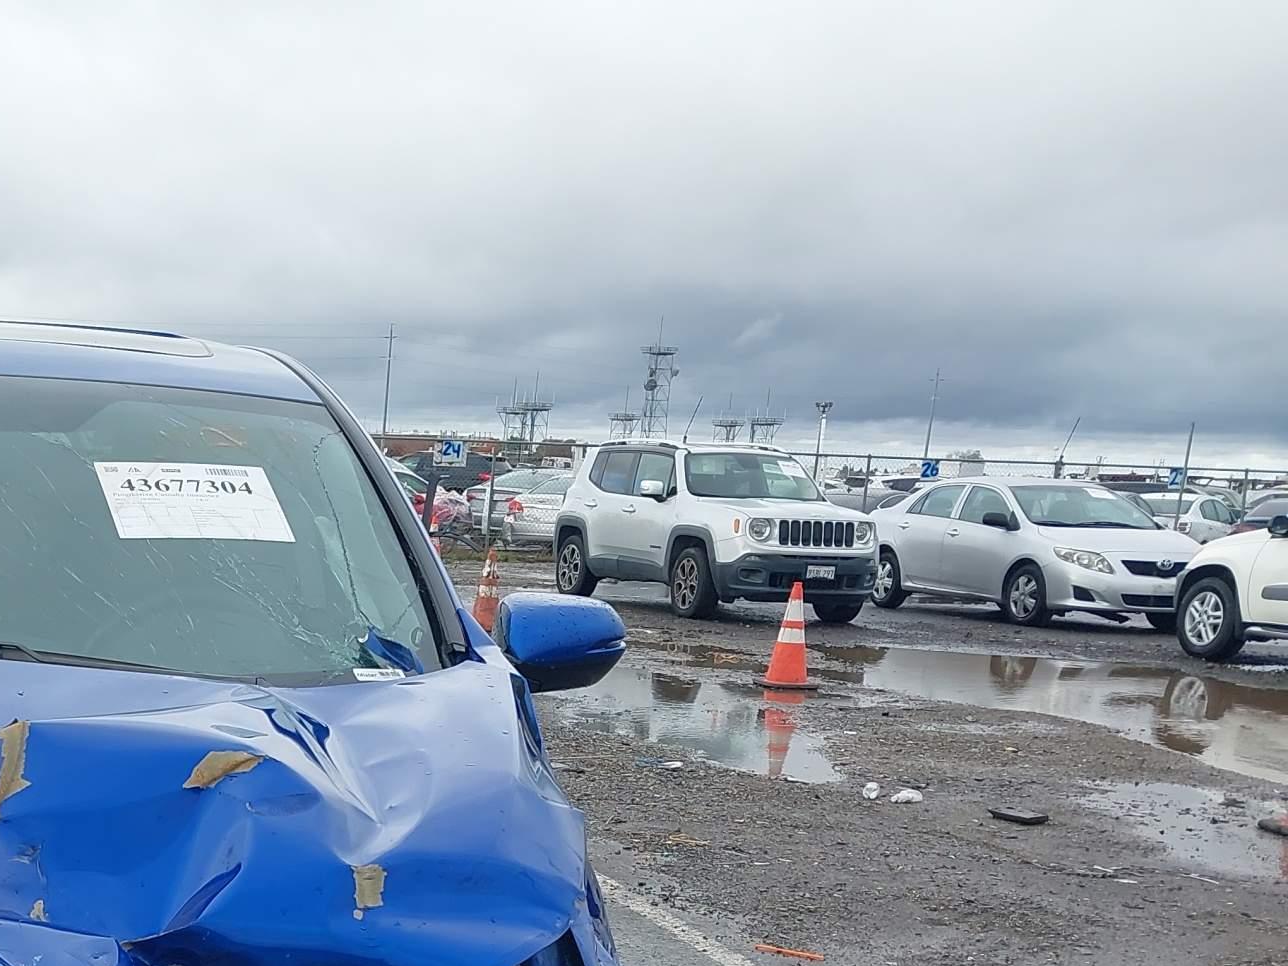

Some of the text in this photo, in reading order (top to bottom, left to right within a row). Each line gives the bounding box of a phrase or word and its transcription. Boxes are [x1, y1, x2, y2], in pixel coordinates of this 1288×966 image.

[443, 441, 461, 458] 24
[921, 462, 939, 478] 26
[120, 478, 253, 495] 43677304
